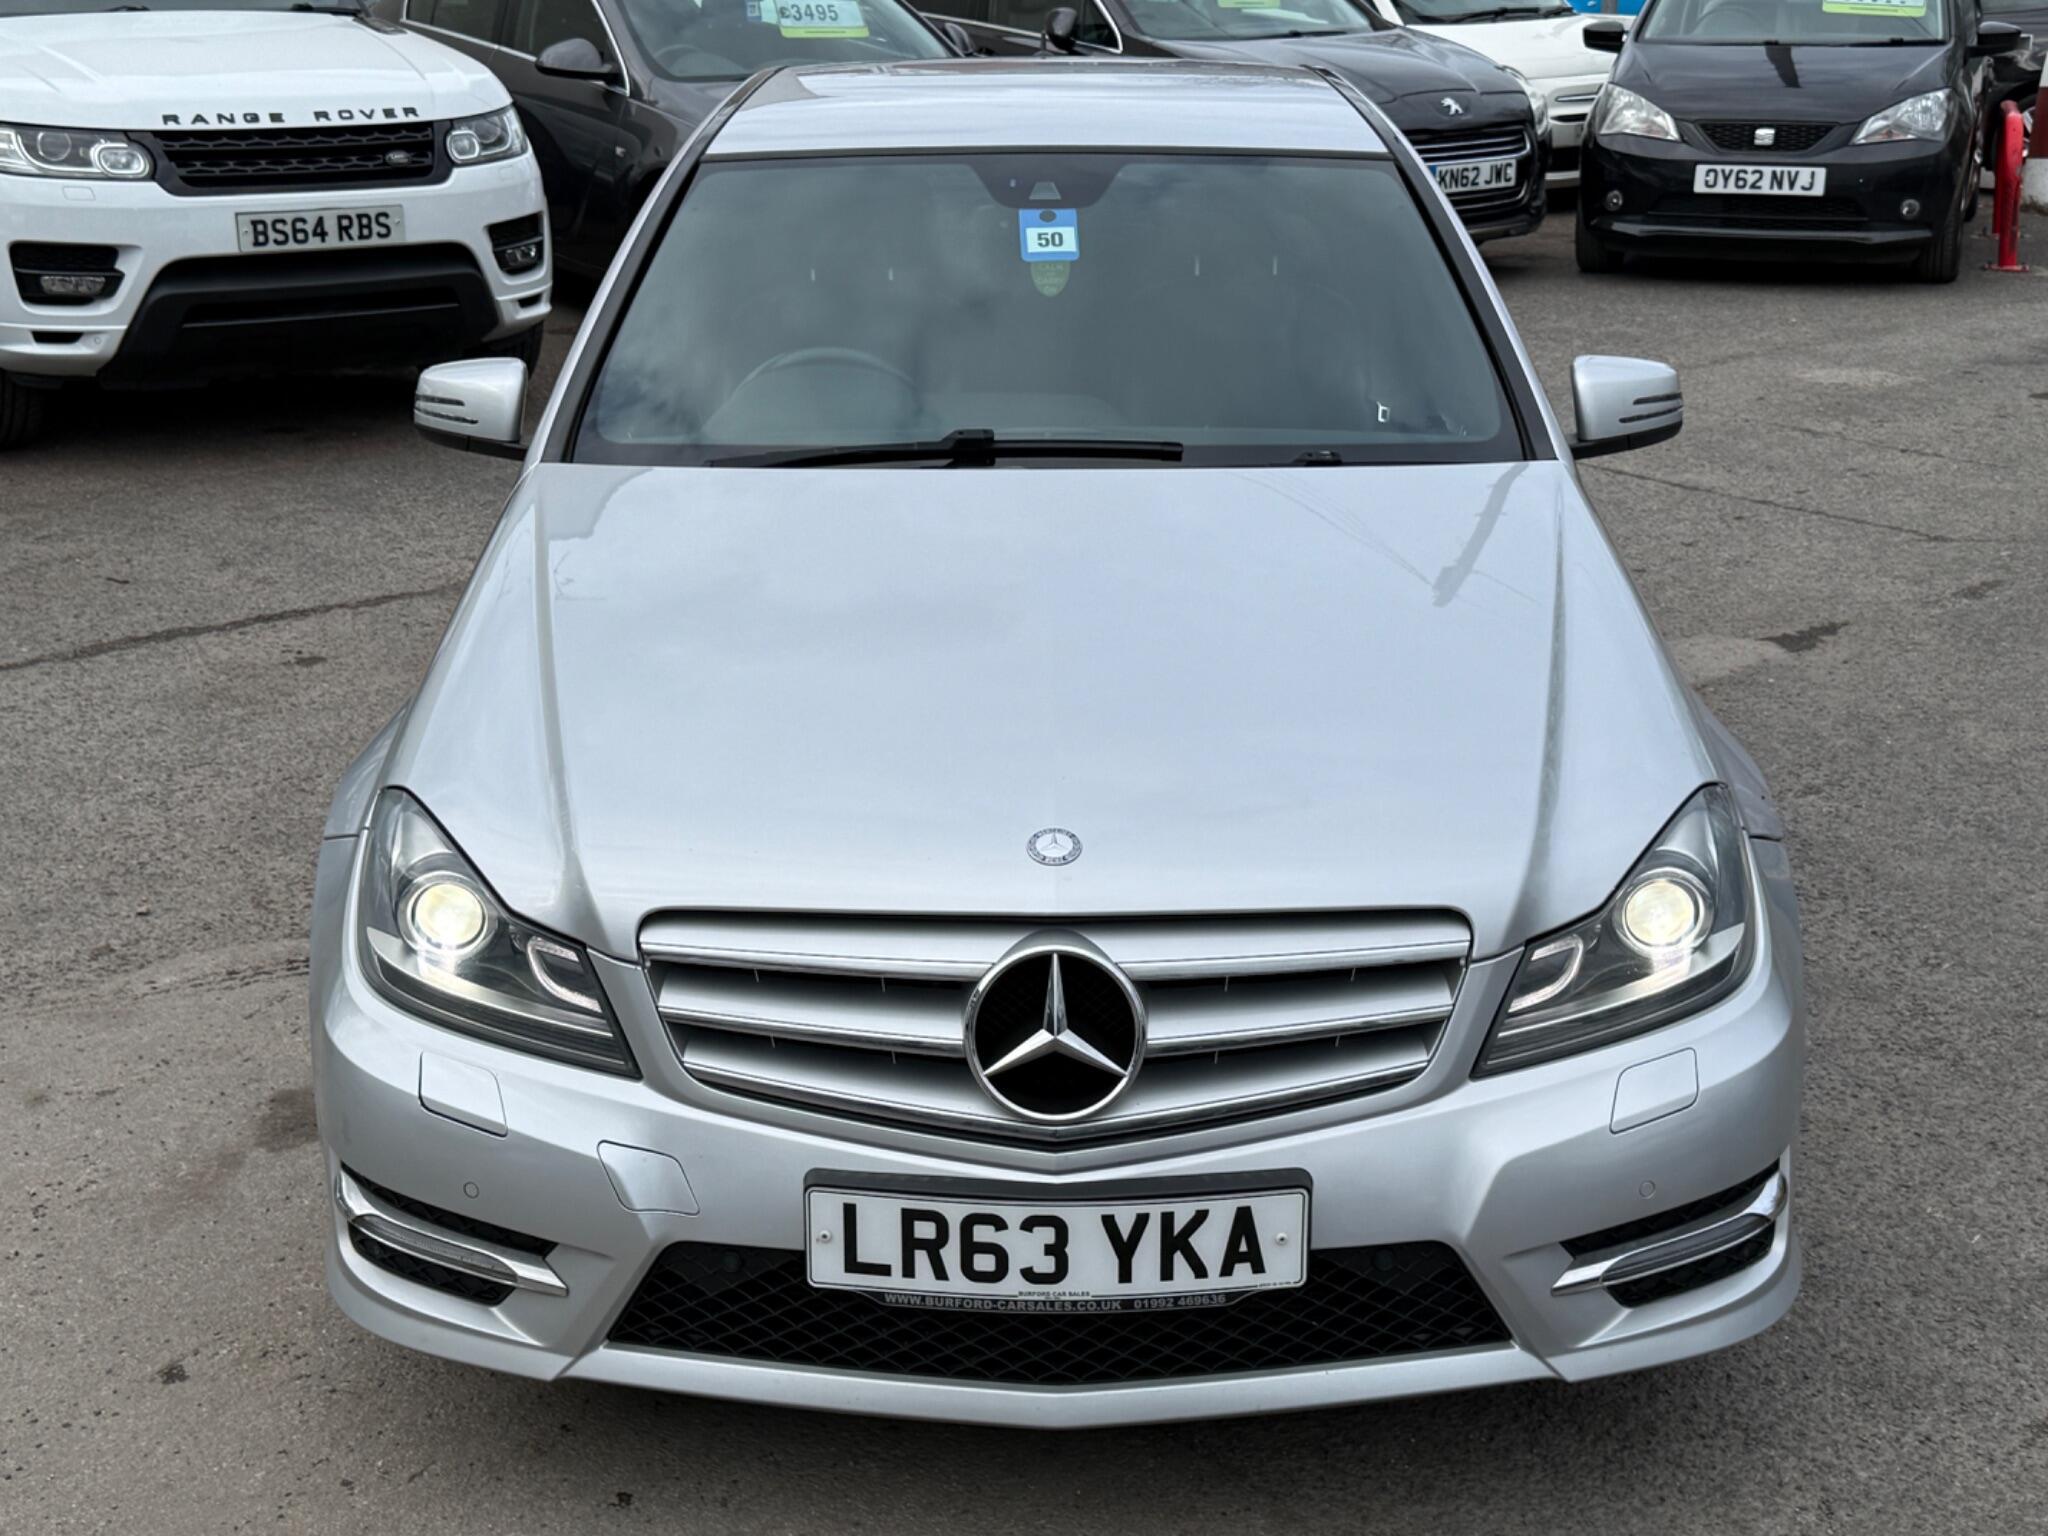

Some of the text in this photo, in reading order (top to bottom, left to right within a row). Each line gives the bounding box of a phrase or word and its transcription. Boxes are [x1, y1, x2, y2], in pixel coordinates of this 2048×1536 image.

[162, 106, 420, 126] RANGE ROVER
[1439, 162, 1513, 190] KN62 JWC
[1704, 168, 1815, 191] OY62 NVJ
[250, 211, 392, 247] BS64 RBS
[1036, 231, 1064, 248] 50
[843, 1202, 1266, 1286] LR63 YKA
[884, 1292, 1122, 1312] WWW.BURFORD-CARSALES.CO.UK
[1133, 1297, 1174, 1309] 01992
[1052, 1290, 1067, 1298] CAR
